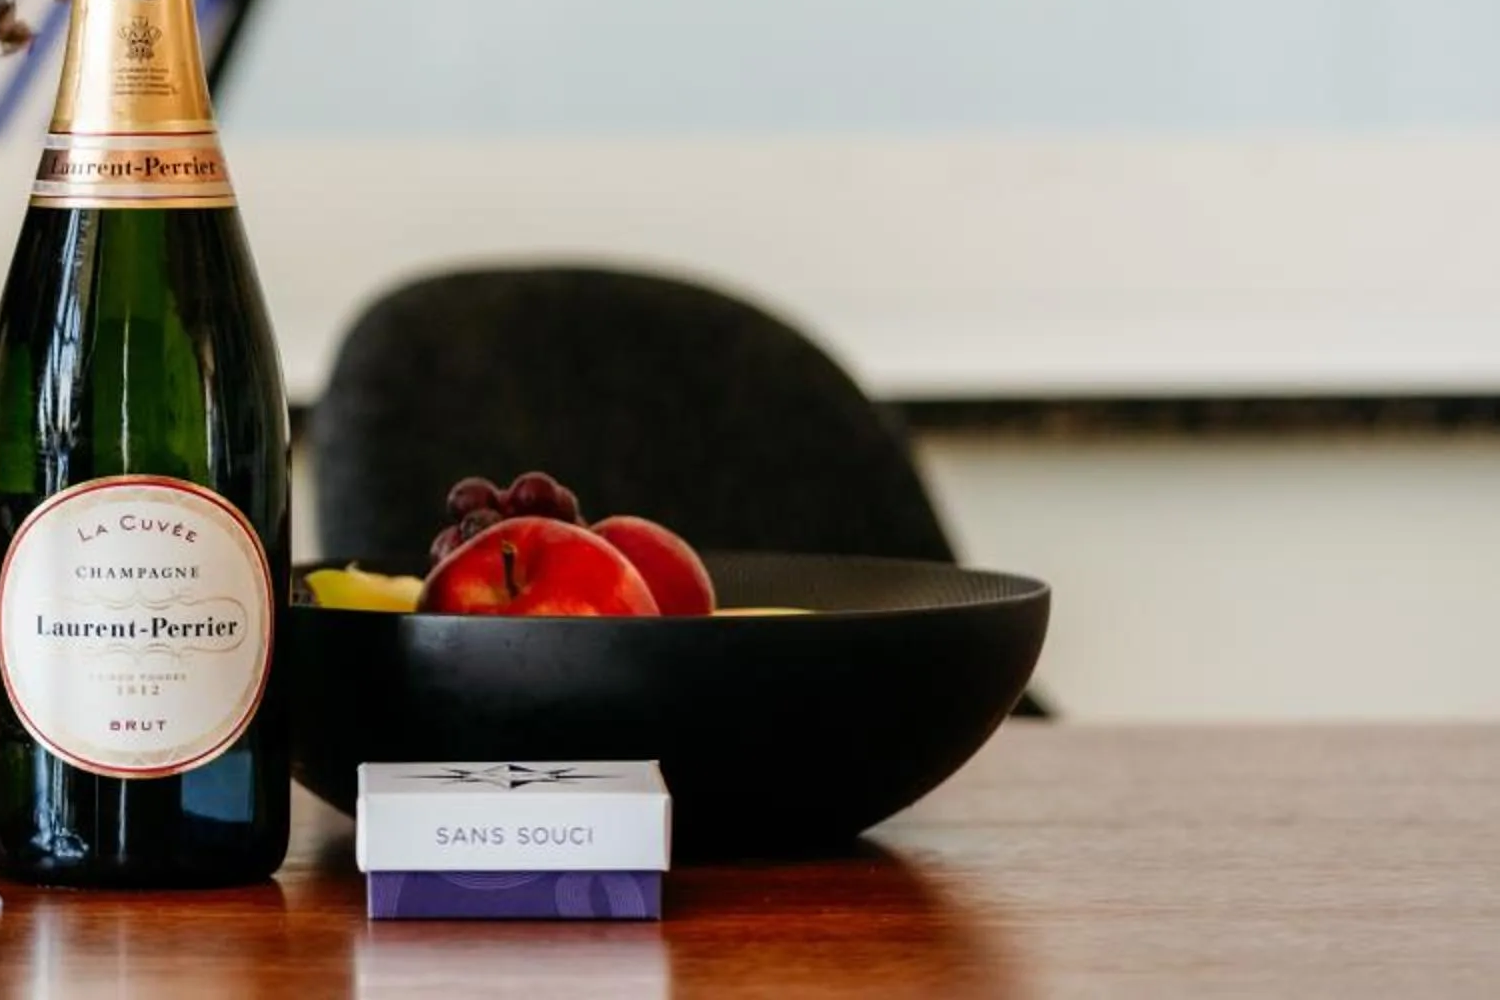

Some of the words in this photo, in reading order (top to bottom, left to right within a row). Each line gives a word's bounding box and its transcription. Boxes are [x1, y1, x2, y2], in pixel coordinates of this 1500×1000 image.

[51, 156, 217, 177] Laurent-Perrier
[75, 566, 200, 579] CHAMPAGNE
[37, 615, 239, 638] Laurent-Perrier
[109, 720, 168, 731] BRUT
[435, 827, 504, 845] SANS
[517, 827, 594, 845] SOUCI
